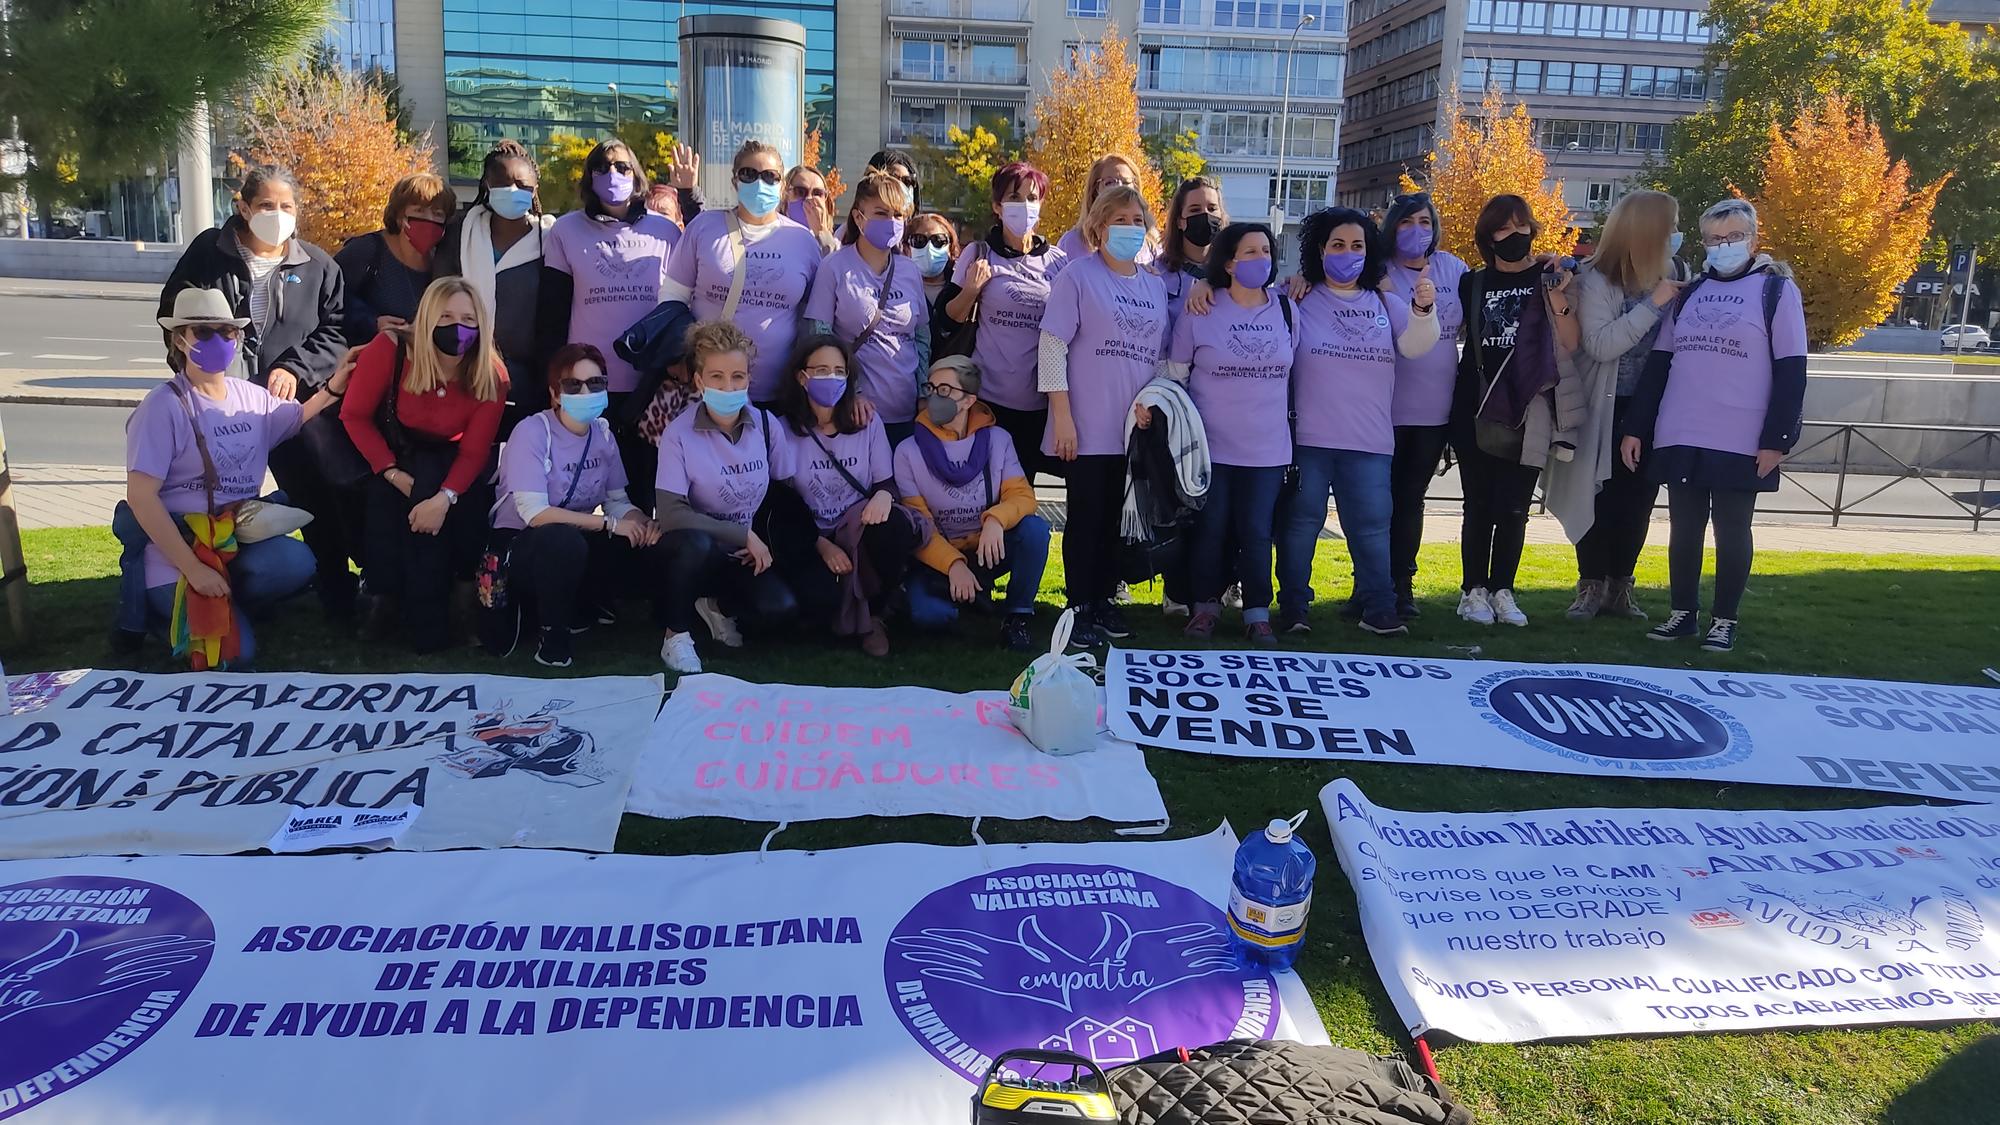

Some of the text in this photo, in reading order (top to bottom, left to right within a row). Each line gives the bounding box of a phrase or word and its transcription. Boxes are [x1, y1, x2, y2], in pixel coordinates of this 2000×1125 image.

[712, 121, 784, 136] EL MADRID
[712, 134, 730, 146] DE
[1957, 255, 1966, 270] P
[584, 294, 638, 305] DEPENDENCIA
[590, 285, 654, 295] POR UNA LEY DE
[754, 290, 772, 299] LEY
[774, 293, 788, 301] DE
[1485, 287, 1534, 299] ELEGANC
[996, 310, 1014, 319] POR
[1016, 312, 1033, 321] UNA
[1228, 323, 1273, 332] AMADD
[1104, 339, 1121, 349] POR
[1322, 342, 1340, 351] POR
[1342, 345, 1361, 353] UNA
[1364, 346, 1380, 354] LEY
[1690, 335, 1707, 343] UNA
[1709, 336, 1726, 345] LEY
[1729, 338, 1741, 348] DE
[1720, 346, 1749, 360] DIGNA
[1310, 347, 1376, 362] DEPENDENCIA
[720, 459, 764, 476] AMADD
[957, 507, 974, 515] UNA
[1125, 653, 1453, 681] LOS SERVICIOS
[66, 676, 479, 714] PLATAFORMA
[1125, 668, 1371, 698] SOCIALES
[1688, 675, 2000, 711] LOS SERVICIO
[1128, 686, 1330, 721] NO SE
[81, 720, 457, 759] CATALUNYA
[703, 720, 913, 749] CUIDEM
[1125, 710, 1417, 757] VENDEN
[1504, 817, 1695, 847] Madrileña
[1695, 820, 1808, 851] Ayuda
[1495, 865, 1547, 883] que
[1553, 864, 1578, 879] la
[1586, 863, 1657, 881] CAM
[1707, 848, 1906, 875] AMADD
[985, 869, 1137, 892] ASOCIACIÓN
[1489, 886, 1532, 902] los
[1540, 883, 1663, 899] servicios
[1666, 886, 1682, 902] y
[970, 889, 1161, 912] VALLISOLETANA
[1402, 900, 1670, 930] que no DEGRADE
[241, 916, 863, 953] ASOCIACIÓN VALLISOLETANA
[1447, 927, 1667, 952] nuestro trabajo
[374, 957, 709, 992] DE AUXILIARES
[1018, 958, 1156, 1012] empatía
[1411, 966, 1511, 1001] SOMOS
[1512, 974, 1671, 998] PERSONAL
[1672, 967, 1857, 996] CUALIFICADO
[1859, 962, 1924, 984] CON
[894, 978, 918, 1005] DE
[1646, 988, 2000, 1020] TODOS ACABAREMOS SIE
[193, 994, 864, 1039] DE AYUDA A LA DEPENDENCIA
[0, 989, 181, 1113] DEPENDENCIA
